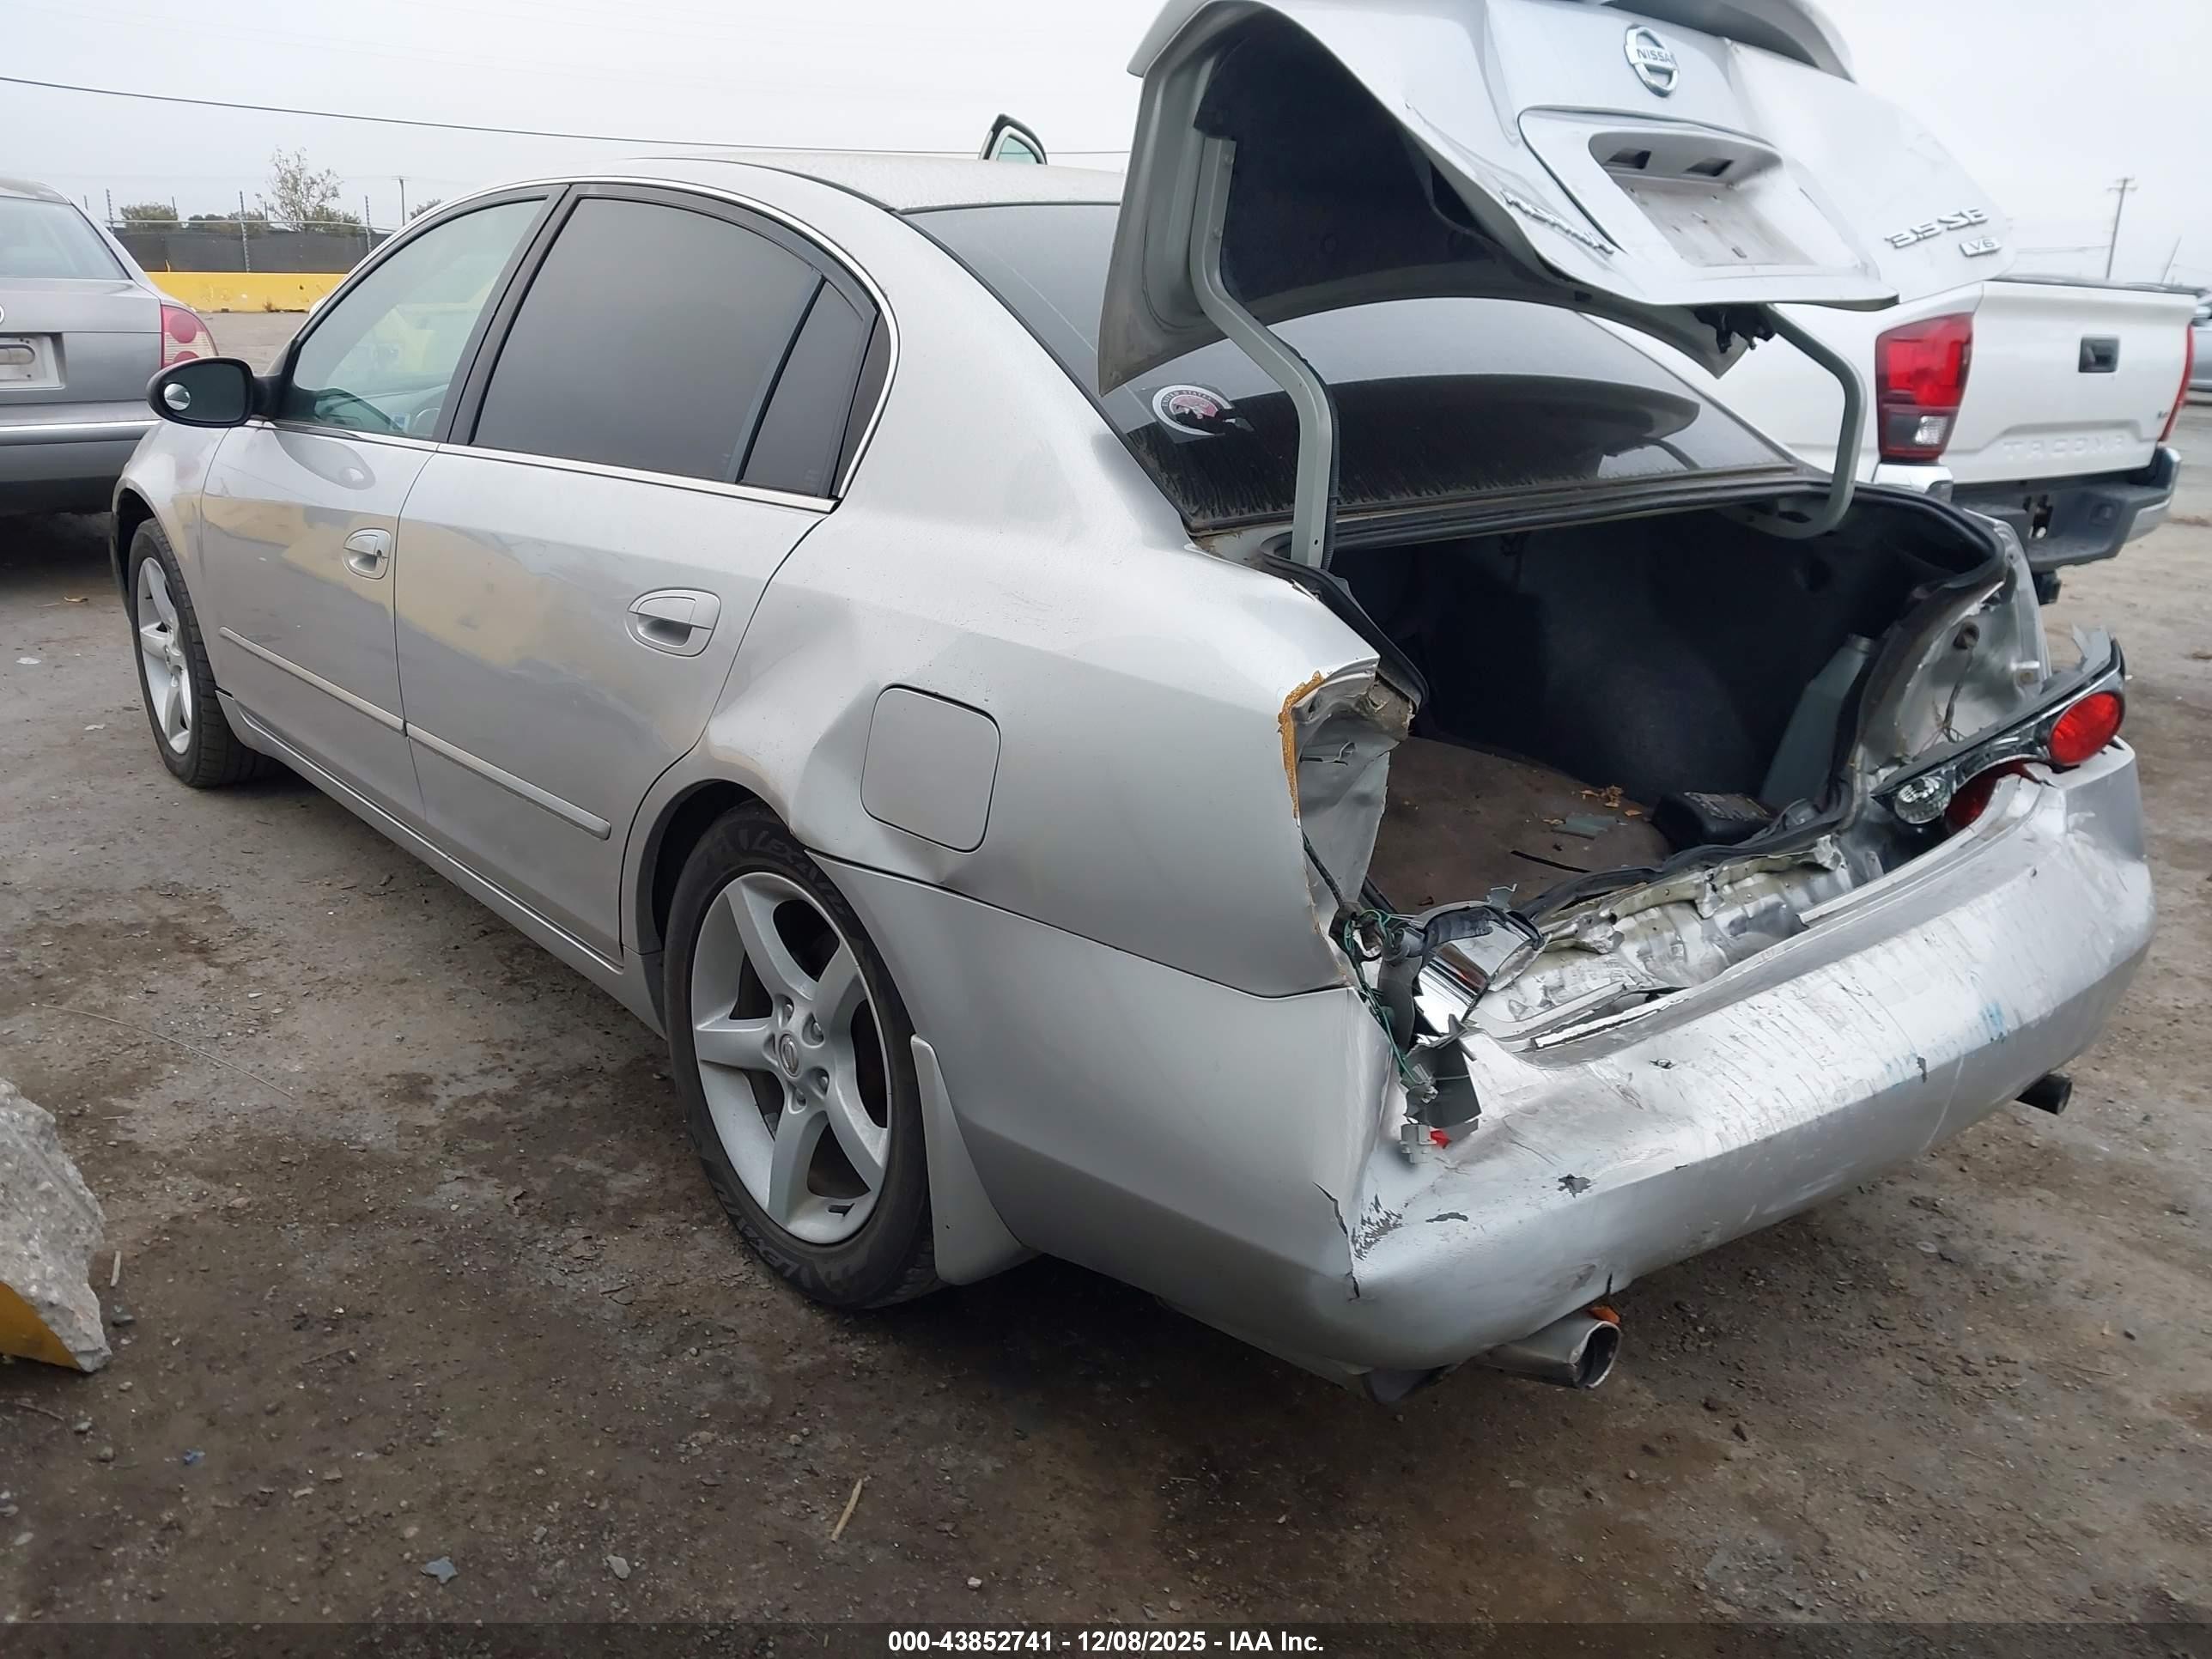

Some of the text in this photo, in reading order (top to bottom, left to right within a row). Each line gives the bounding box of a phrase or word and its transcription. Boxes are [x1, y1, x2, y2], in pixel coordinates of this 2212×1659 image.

[1884, 206, 1989, 249] 3.5 SE
[1968, 239, 1996, 251] V6
[2003, 435, 2125, 459] TACOMA
